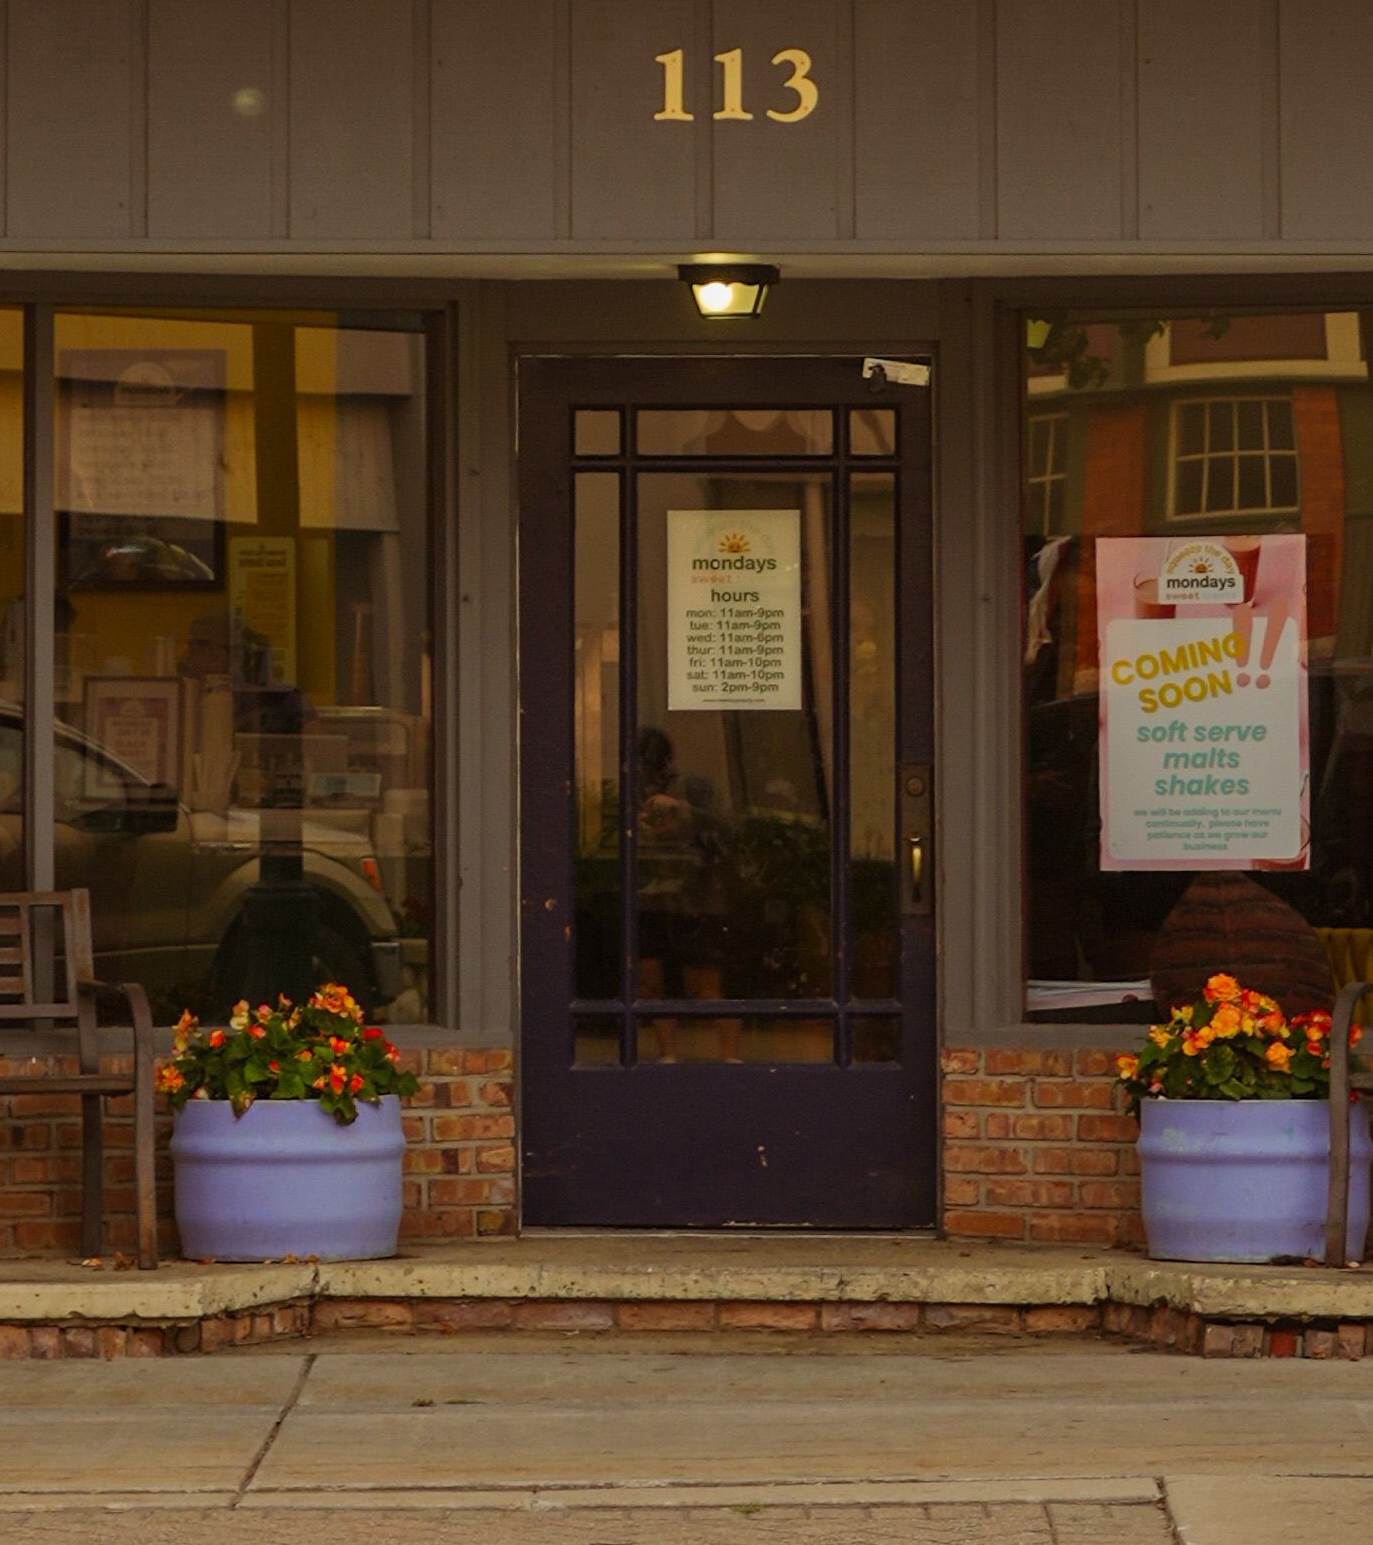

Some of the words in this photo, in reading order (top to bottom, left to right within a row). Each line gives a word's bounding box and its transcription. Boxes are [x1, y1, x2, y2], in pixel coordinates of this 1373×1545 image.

[653, 47, 819, 123] 113
[692, 556, 777, 573] mondays
[1167, 576, 1236, 590] mondays
[711, 589, 759, 602] hours
[686, 610, 716, 618] mon:
[720, 608, 784, 619] 11am-9pm
[717, 620, 781, 631] 11am-9pm
[686, 633, 716, 643] wed:
[687, 645, 715, 655] thur:
[689, 657, 707, 667] fri:
[710, 658, 781, 669] 11am-10pm
[1111, 632, 1246, 686] COMING
[687, 670, 708, 680] sat:
[713, 670, 784, 681] 11am-10pm
[693, 683, 717, 692] sun:
[721, 682, 779, 693] 2pm-9pm
[1139, 669, 1234, 713] SOON
[1137, 720, 1188, 742] soft
[1193, 724, 1267, 742] serve
[1163, 747, 1240, 769] malts
[1154, 774, 1250, 796] shakes
